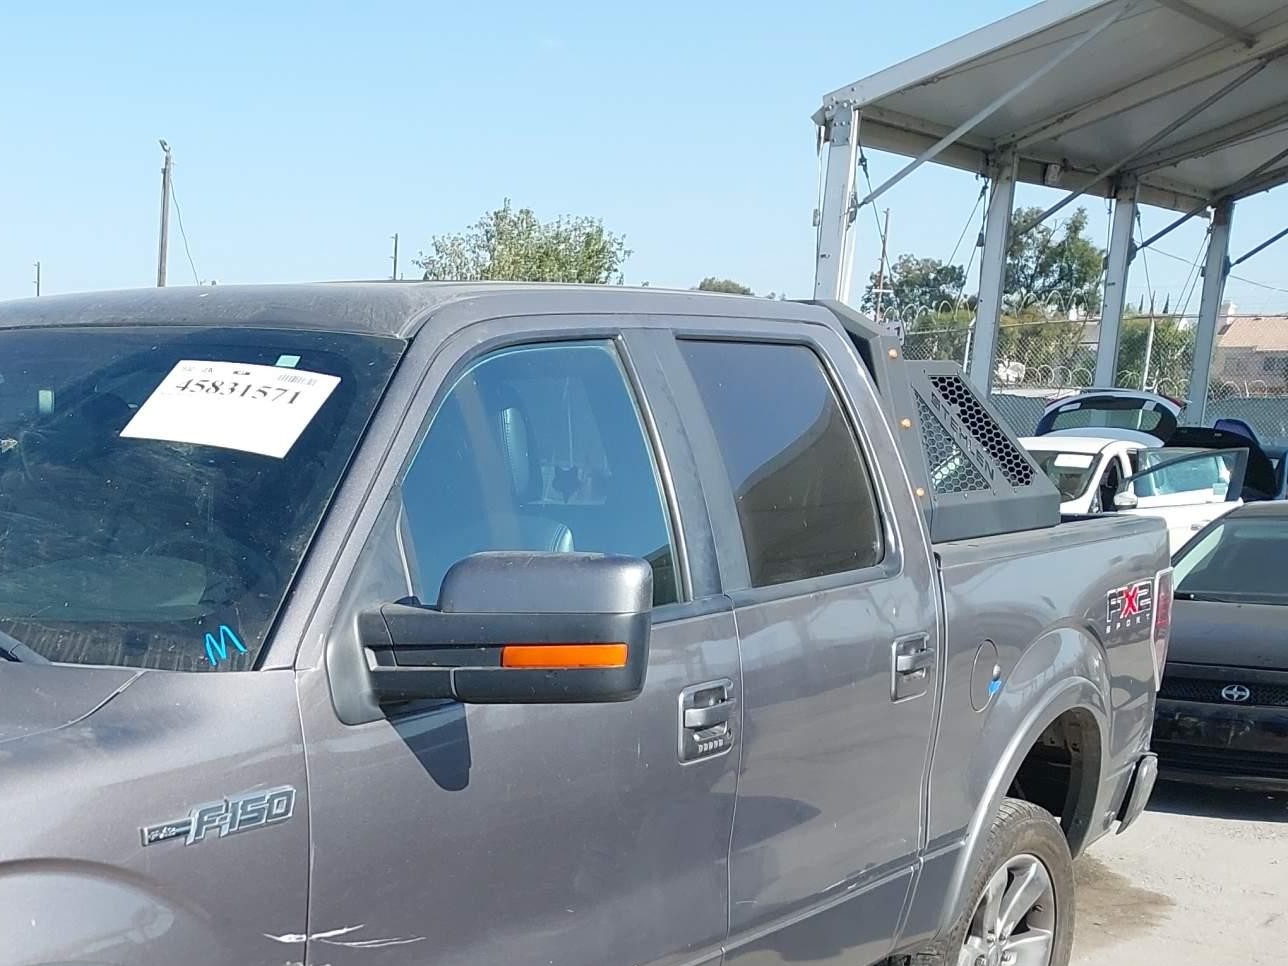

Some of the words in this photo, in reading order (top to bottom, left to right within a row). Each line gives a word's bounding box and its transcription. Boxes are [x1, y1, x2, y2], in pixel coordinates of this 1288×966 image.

[176, 378, 300, 404] 45831571
[1106, 580, 1152, 623] FX2
[1105, 613, 1151, 634] SPORT
